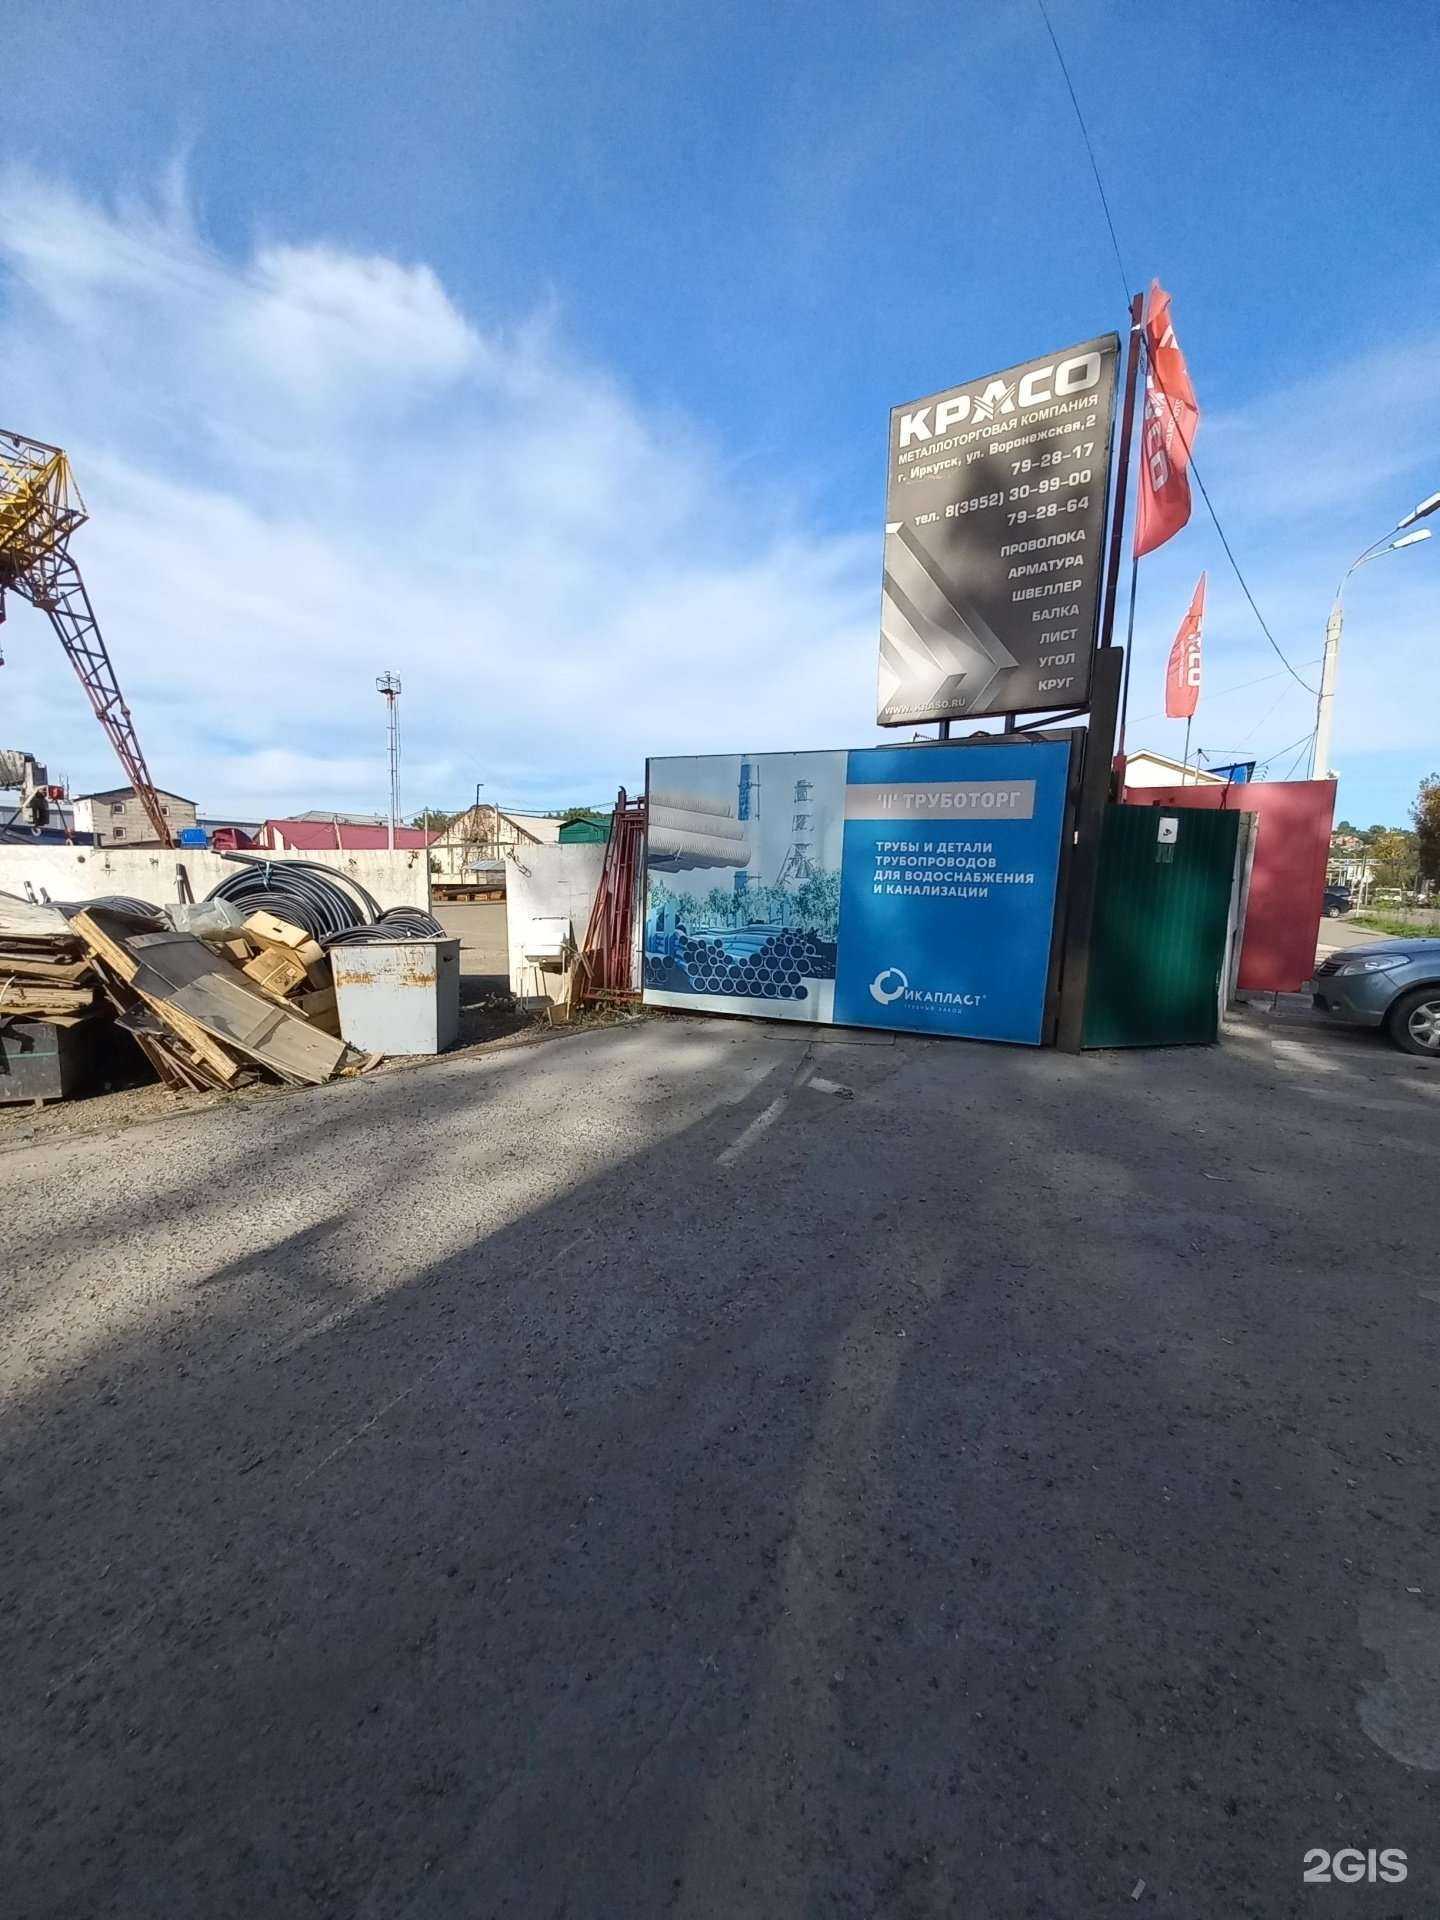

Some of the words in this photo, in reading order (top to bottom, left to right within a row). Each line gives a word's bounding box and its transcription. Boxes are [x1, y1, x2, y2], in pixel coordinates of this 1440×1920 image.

[899, 351, 1101, 448] КРАСО
[898, 418, 1018, 465] МЕТАЛЛОТОРГОВАЯ
[1020, 394, 1098, 426] КОМПАНИЯ
[897, 472, 906, 483] г.
[910, 457, 962, 479] Иркутск,
[966, 450, 984, 465] ул.
[1010, 442, 1095, 477] 79-28-17
[914, 512, 940, 527] тел.
[945, 491, 1005, 518] 8(3952)
[1008, 469, 1092, 502] 30-99-00
[1006, 496, 1090, 527] 79-28-64
[1000, 529, 1086, 558] ПРОВОЛОКА
[1007, 554, 1084, 580] АРМАТУРА
[1012, 579, 1082, 602] ШВЕЛЛЕР
[1031, 604, 1080, 622] БАЛКА
[1039, 628, 1079, 645] ЛИСТ
[1038, 652, 1076, 668] УГОЛ
[1037, 677, 1075, 692] КРУГ
[903, 791, 1021, 809] ТРУБОТОРГ
[876, 841, 920, 852] ТРУБЫ
[923, 842, 933, 851] И
[936, 842, 993, 854] ДЕТАЛИ
[875, 856, 997, 869] ТРУБОПРОВОДОВ
[873, 870, 902, 882] ДЛЯ
[904, 870, 1034, 884] ВОДОСНАБЖЕНИЯ
[873, 885, 882, 894] И
[886, 885, 989, 898] КАНАЛИЗАЦИИ
